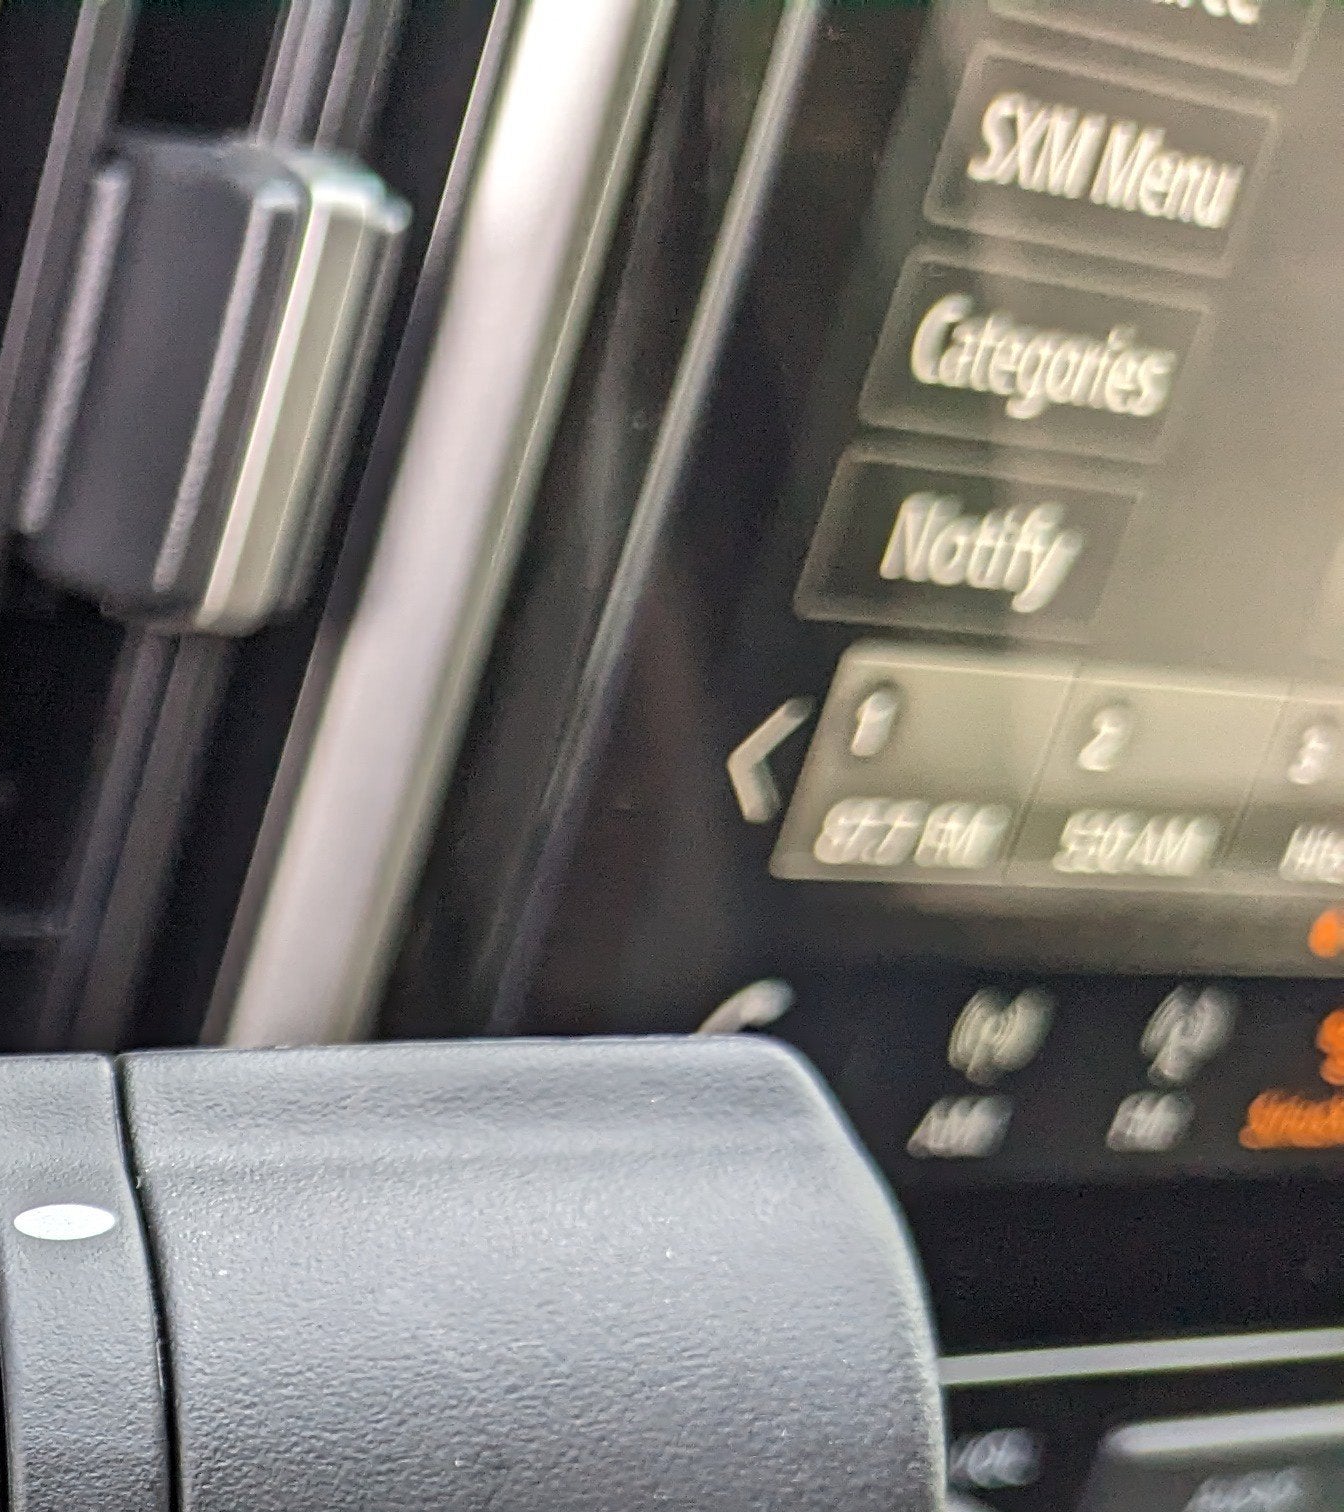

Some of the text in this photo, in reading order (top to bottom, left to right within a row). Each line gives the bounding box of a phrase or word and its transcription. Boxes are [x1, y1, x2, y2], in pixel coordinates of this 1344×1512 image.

[967, 91, 1244, 229] SXM Menu
[911, 292, 1178, 420] Categories
[879, 491, 1084, 613] Notify
[850, 689, 897, 758] 1
[1128, 812, 1220, 877] AM
